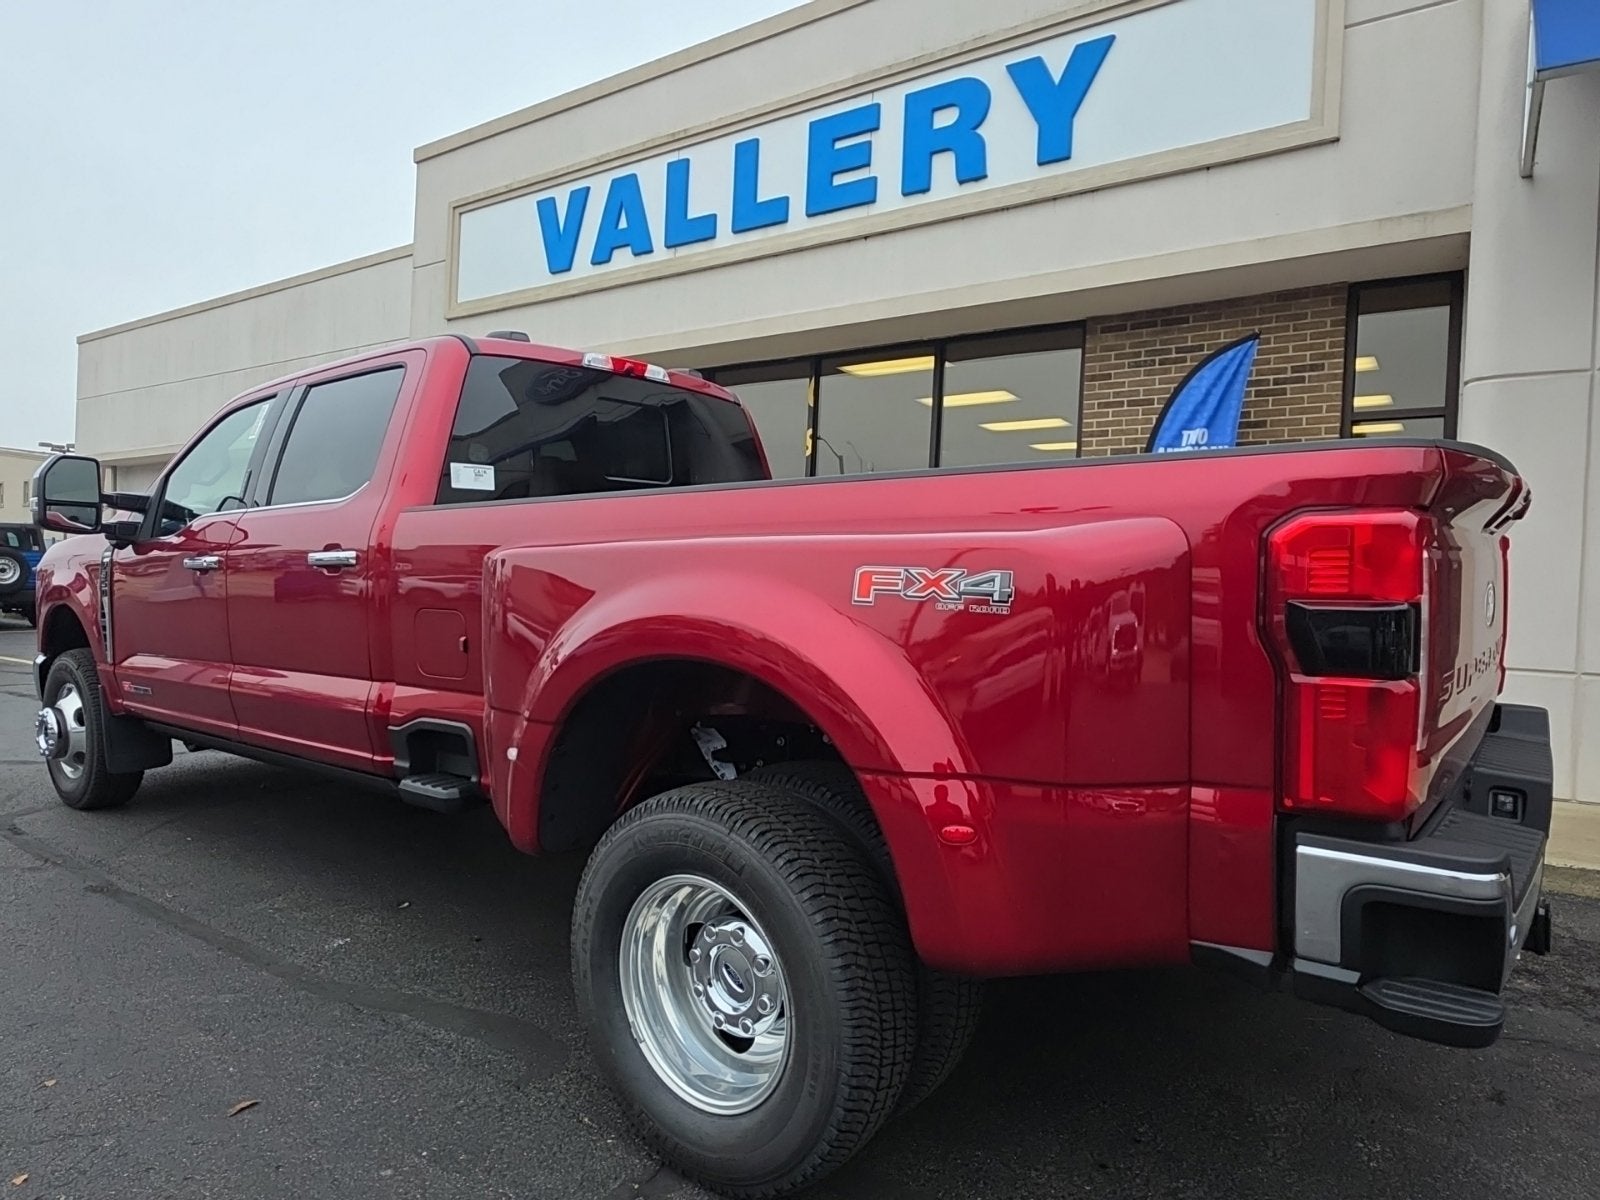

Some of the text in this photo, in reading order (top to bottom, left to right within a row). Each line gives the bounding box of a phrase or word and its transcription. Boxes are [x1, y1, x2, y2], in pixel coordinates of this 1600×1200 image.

[536, 34, 1116, 275] VALLERY
[852, 566, 1015, 606] FX4
[935, 603, 1010, 615] OFF ROAD
